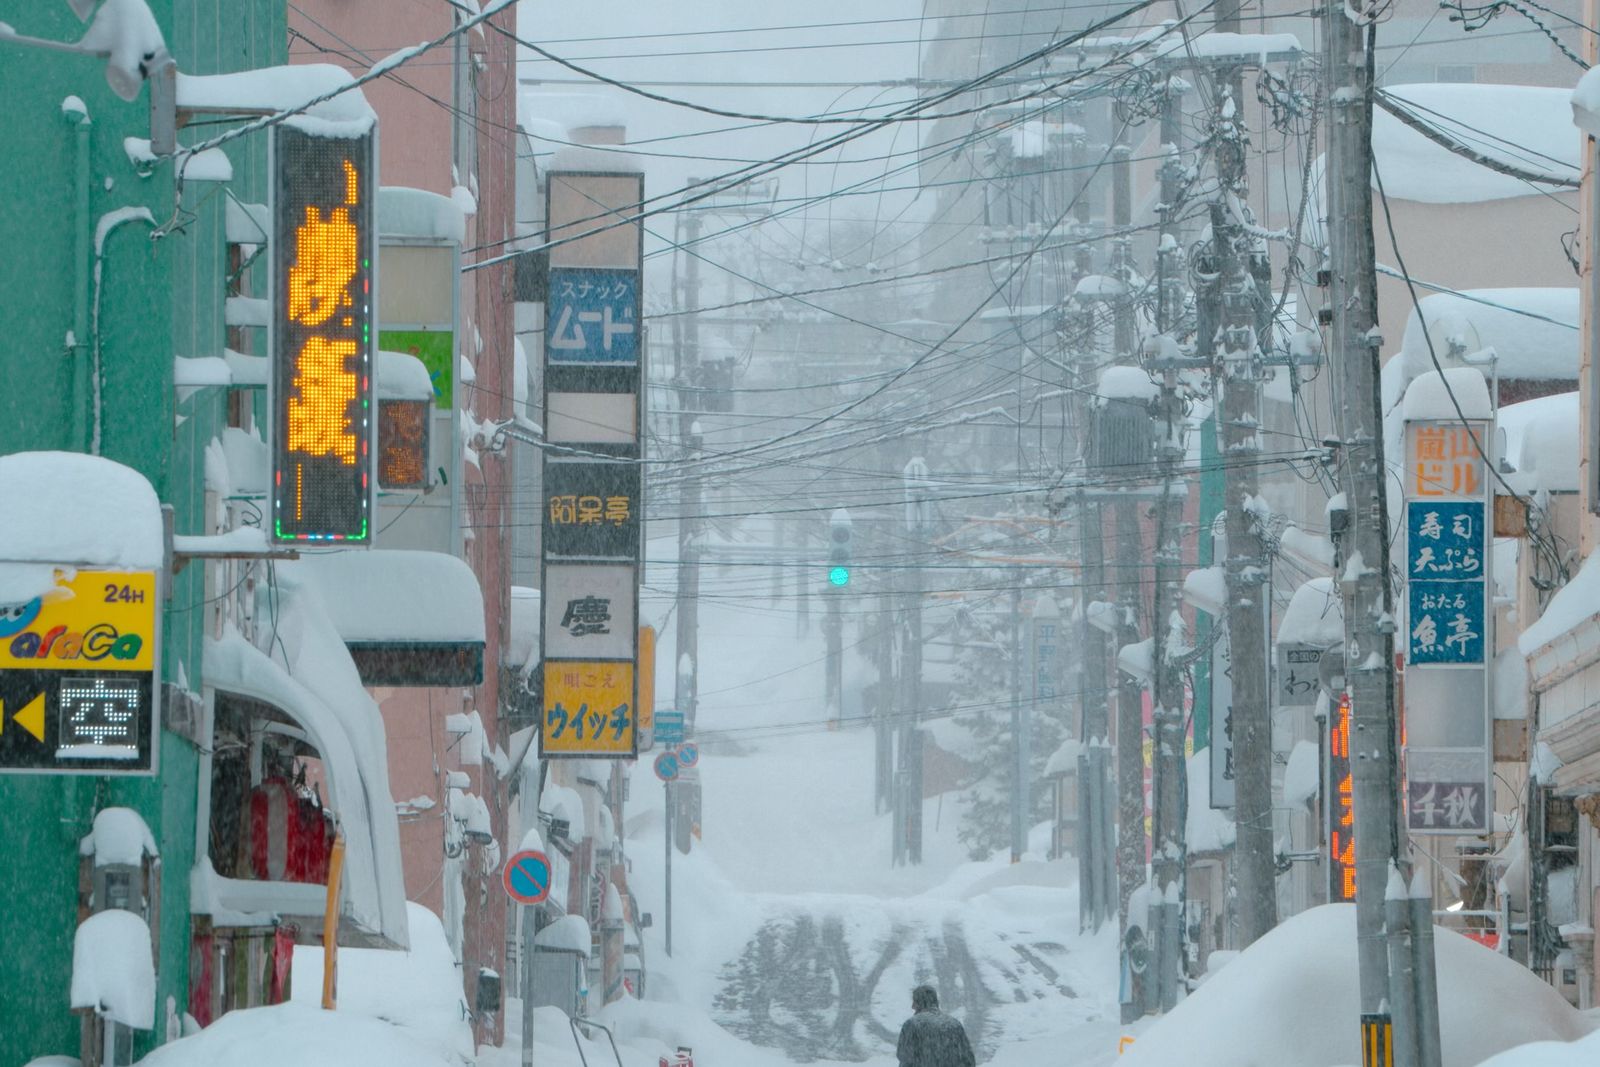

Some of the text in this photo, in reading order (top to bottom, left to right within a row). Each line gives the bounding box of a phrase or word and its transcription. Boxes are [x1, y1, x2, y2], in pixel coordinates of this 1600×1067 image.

[560, 281, 628, 299] スナック
[550, 304, 635, 351] ムード
[1416, 426, 1481, 461] 嵐山
[1416, 463, 1479, 496] ビル
[1418, 511, 1472, 539] 寿司
[1413, 547, 1480, 573] 天ぷら
[104, 584, 144, 604] 24H
[1421, 592, 1467, 609] おたる
[1412, 613, 1479, 656] 魚亭
[61, 678, 138, 750] 空
[547, 702, 630, 741] ウイッチ
[1412, 783, 1479, 826] 千秋
